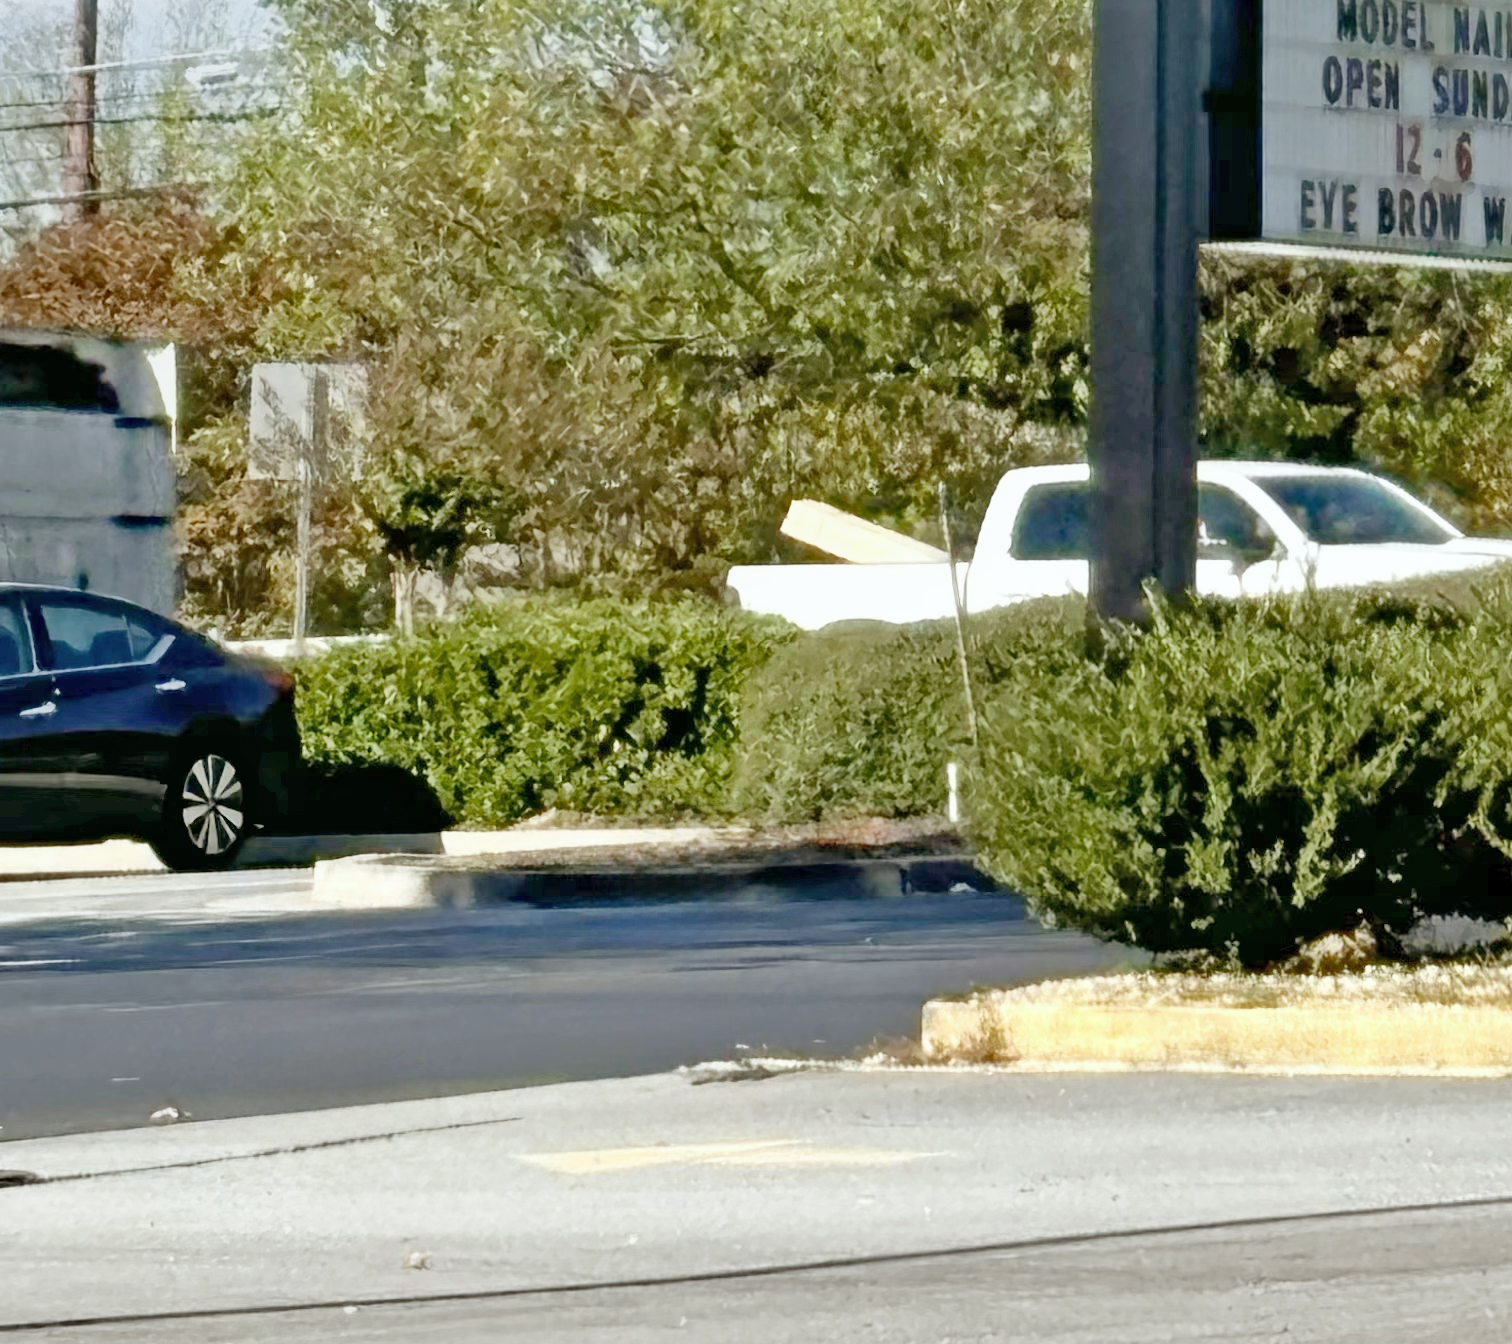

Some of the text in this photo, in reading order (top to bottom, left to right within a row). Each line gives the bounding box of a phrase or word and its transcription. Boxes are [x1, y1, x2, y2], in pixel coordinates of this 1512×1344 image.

[1321, 55, 1401, 111] OPEN
[1301, 179, 1358, 234] EYE
[1377, 186, 1463, 242] BROW
